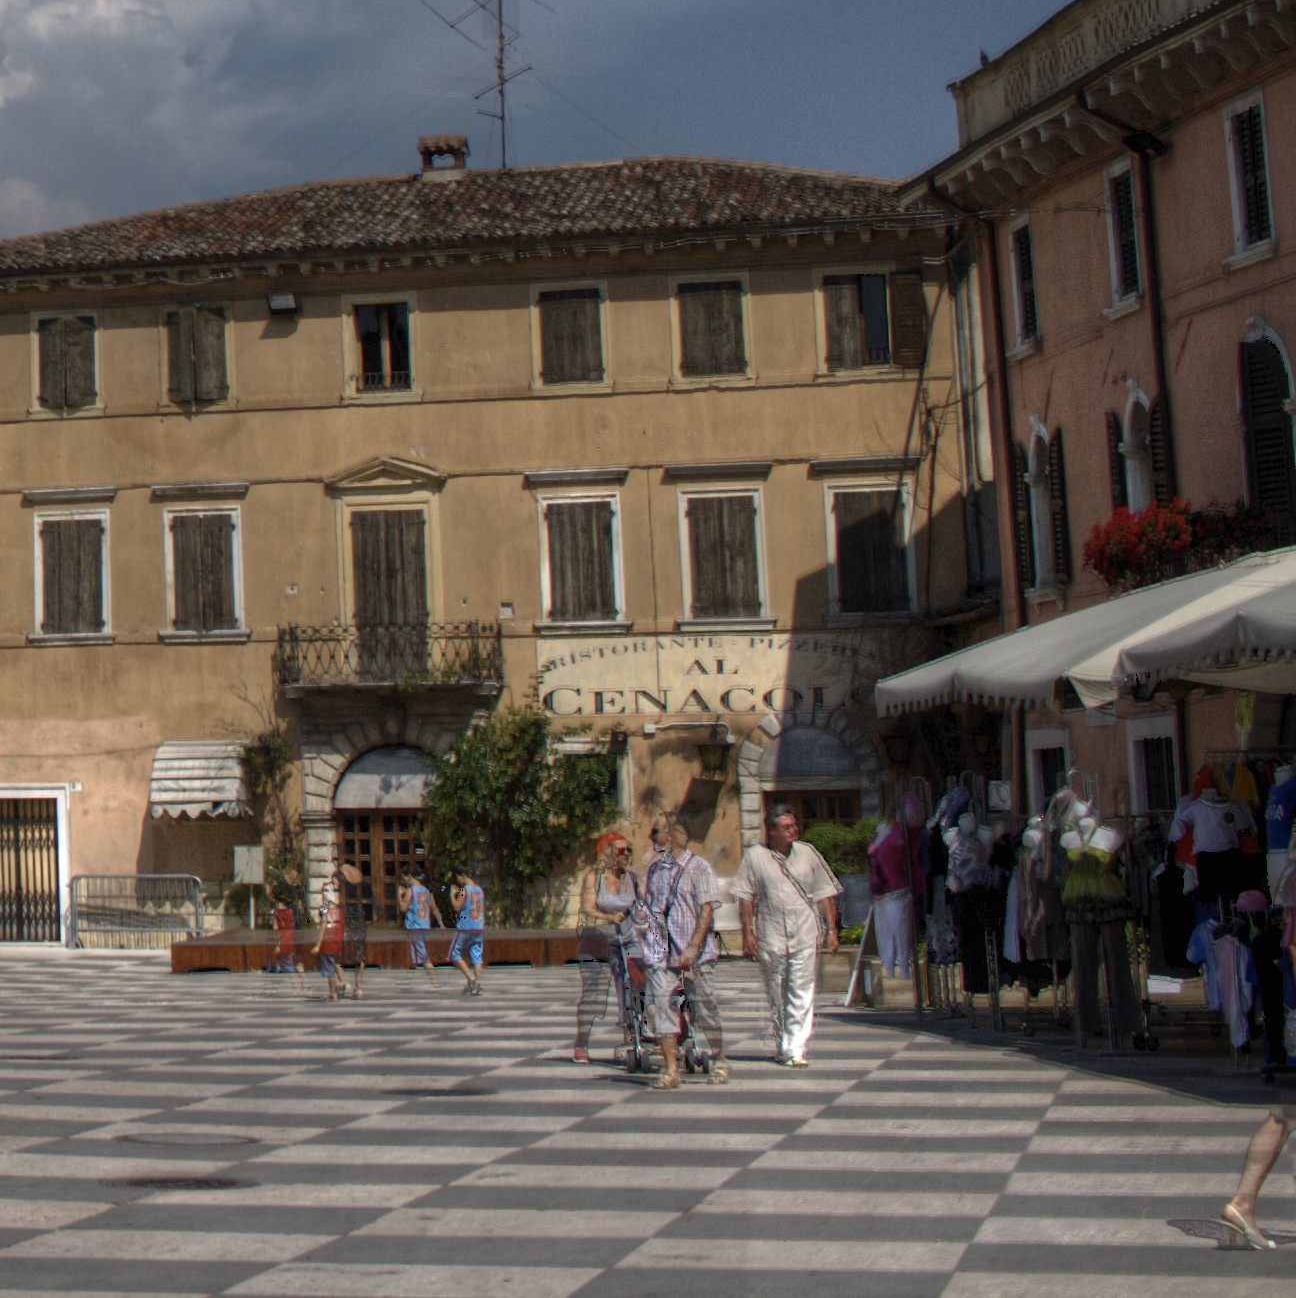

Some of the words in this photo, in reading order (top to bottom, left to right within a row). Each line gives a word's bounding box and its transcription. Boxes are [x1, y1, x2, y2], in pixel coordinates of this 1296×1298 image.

[548, 635, 722, 670] RISTORANTE
[683, 656, 739, 676] AL
[417, 892, 430, 920] 5
[469, 892, 483, 920] 5
